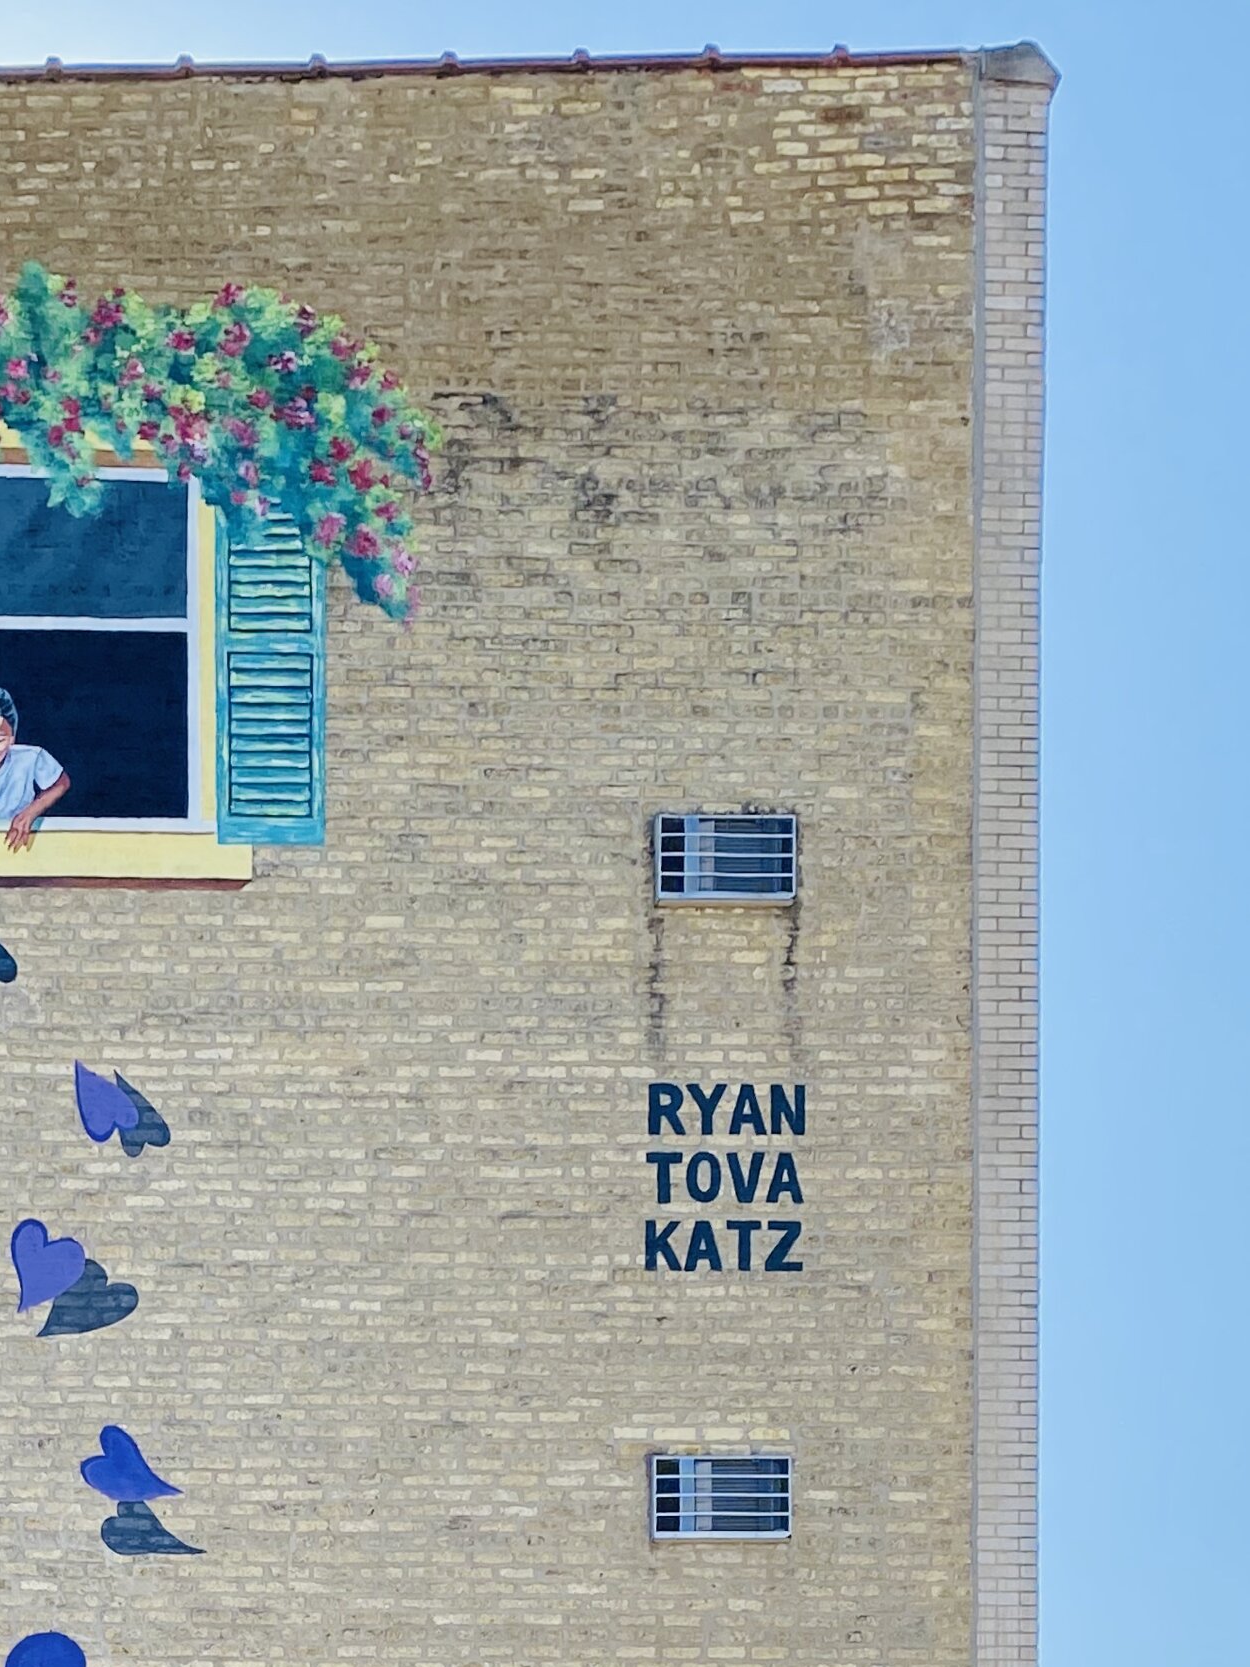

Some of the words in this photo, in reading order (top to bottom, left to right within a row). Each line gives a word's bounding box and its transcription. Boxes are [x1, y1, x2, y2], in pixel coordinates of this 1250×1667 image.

[648, 1083, 806, 1135] RYAN
[646, 1152, 804, 1204] TOVA
[644, 1219, 803, 1271] KATZ
